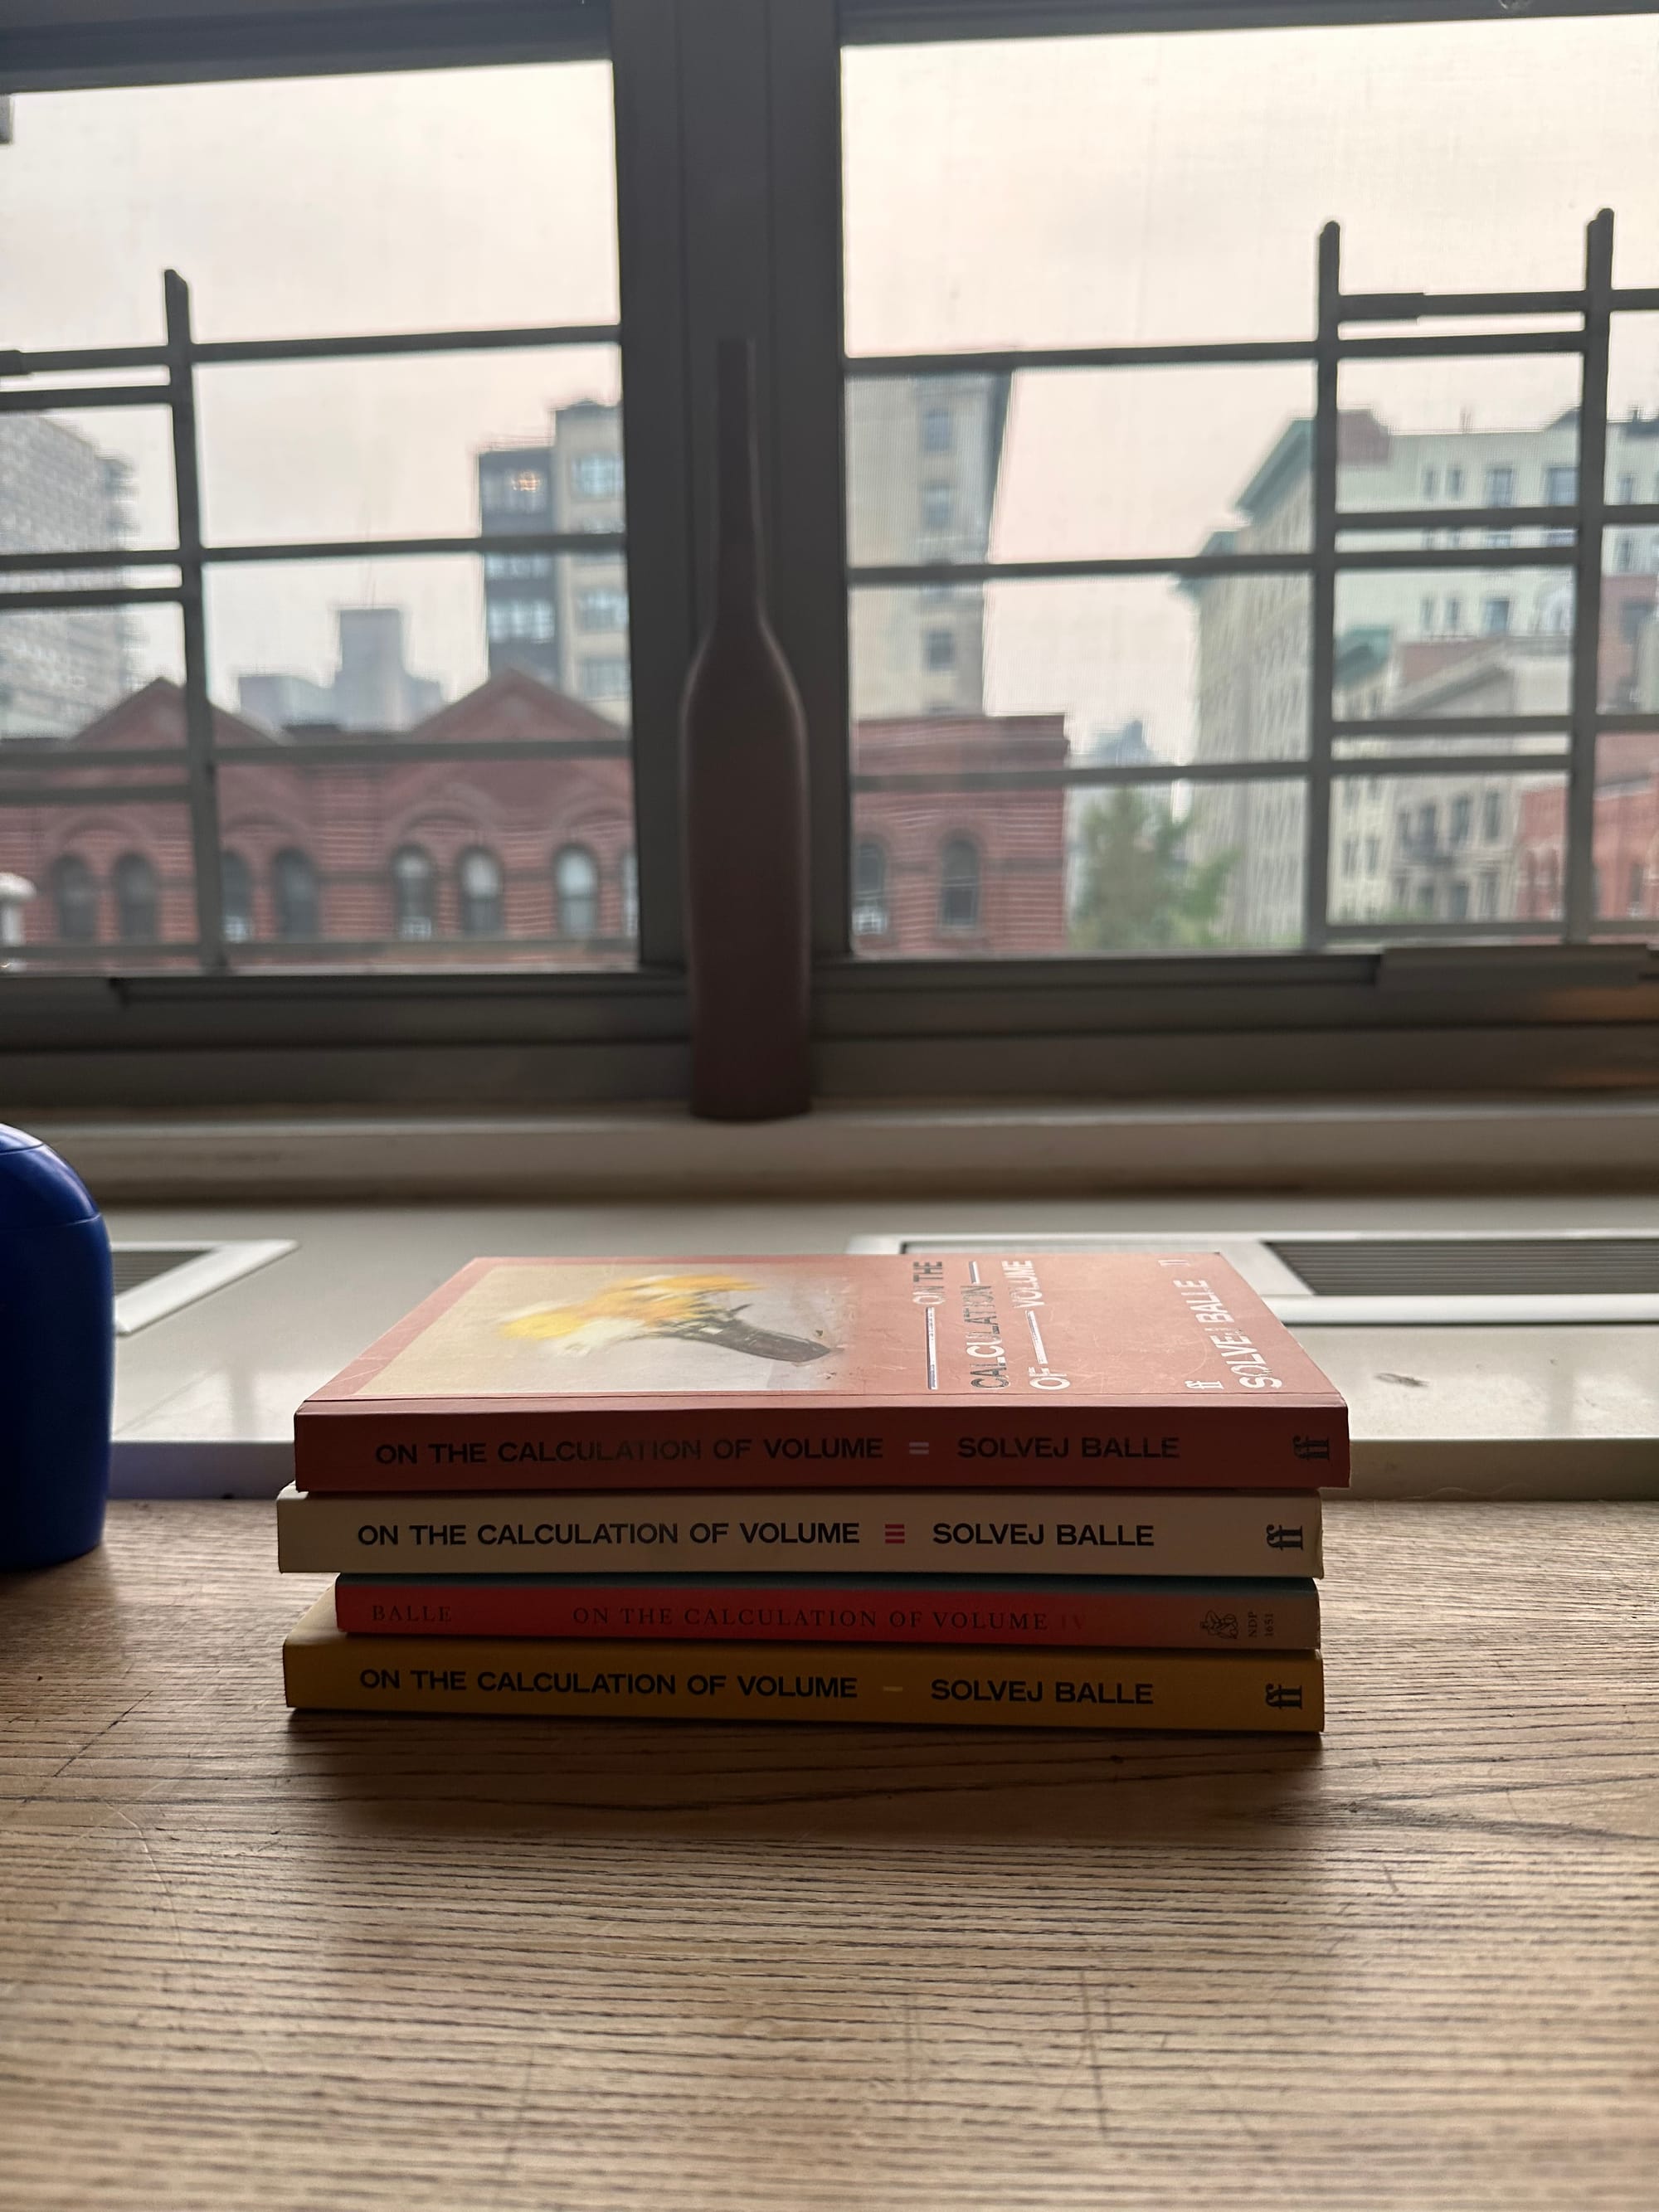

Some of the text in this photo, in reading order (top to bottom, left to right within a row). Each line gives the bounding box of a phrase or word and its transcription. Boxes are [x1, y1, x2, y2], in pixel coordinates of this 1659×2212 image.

[912, 1262, 945, 1305] ON THE
[1173, 1280, 1234, 1323] BALLE
[960, 1286, 1010, 1388] CALCULATION
[1001, 1260, 1070, 1390] OF VOLUME
[375, 1438, 883, 1466] ON THE CALCULATION OF VOLUME
[957, 1437, 1180, 1458] SOLVEJ BALLE
[358, 1523, 859, 1545] ON THE CALCULATION OF VOLUME
[933, 1524, 1154, 1546] SOLVEJ BALLE
[372, 1606, 452, 1622] BALLE
[572, 1607, 608, 1625] ON
[620, 1608, 672, 1626] THE
[684, 1607, 877, 1628] CALCULATION
[890, 1611, 922, 1628] OF
[933, 1612, 1048, 1631] VOLUME
[1248, 1612, 1257, 1636] NDP
[1265, 1613, 1274, 1636] 1651
[360, 1670, 857, 1698] ON THE CALCULATION OF VOLUME
[932, 1680, 1153, 1704] SOLVEJ BALLE
